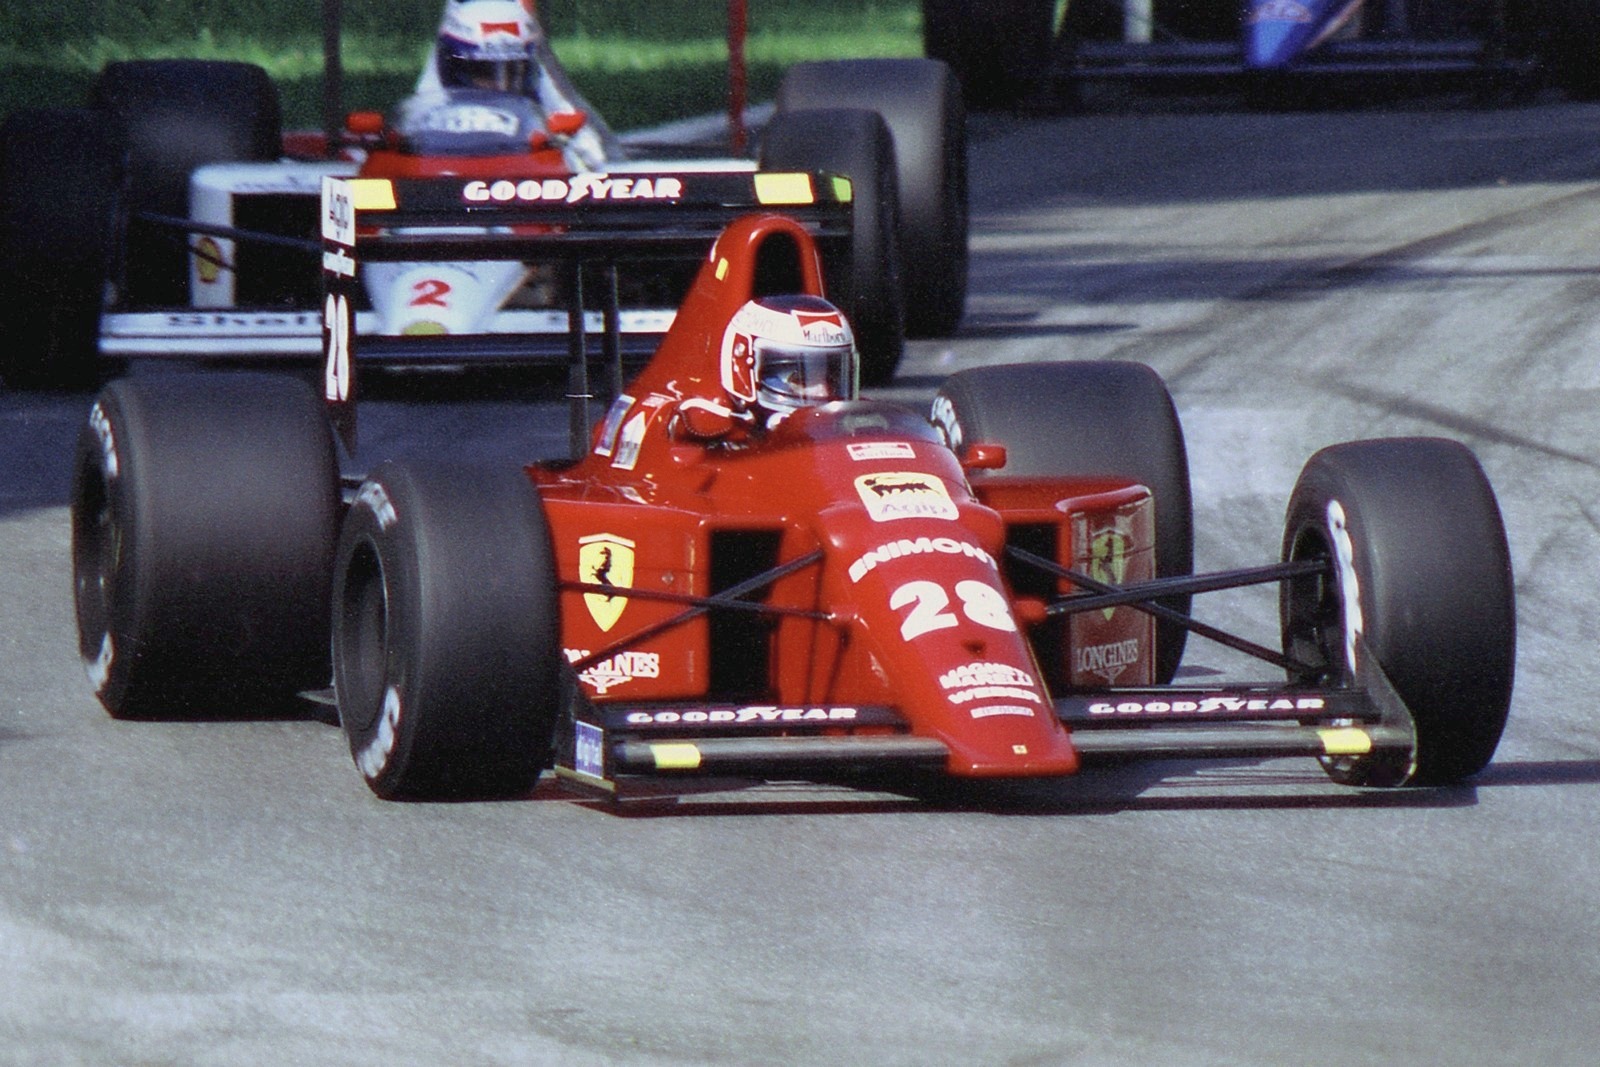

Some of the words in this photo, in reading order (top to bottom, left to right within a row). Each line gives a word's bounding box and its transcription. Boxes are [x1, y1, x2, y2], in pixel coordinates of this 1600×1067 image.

[463, 172, 682, 203] GOODYEAR
[409, 279, 452, 308] 2
[326, 293, 350, 401] 28
[890, 580, 1017, 642] 28
[1076, 638, 1139, 673] LONGINES
[627, 706, 858, 723] GOODYEAR
[1088, 697, 1325, 714] GOODYEAR
